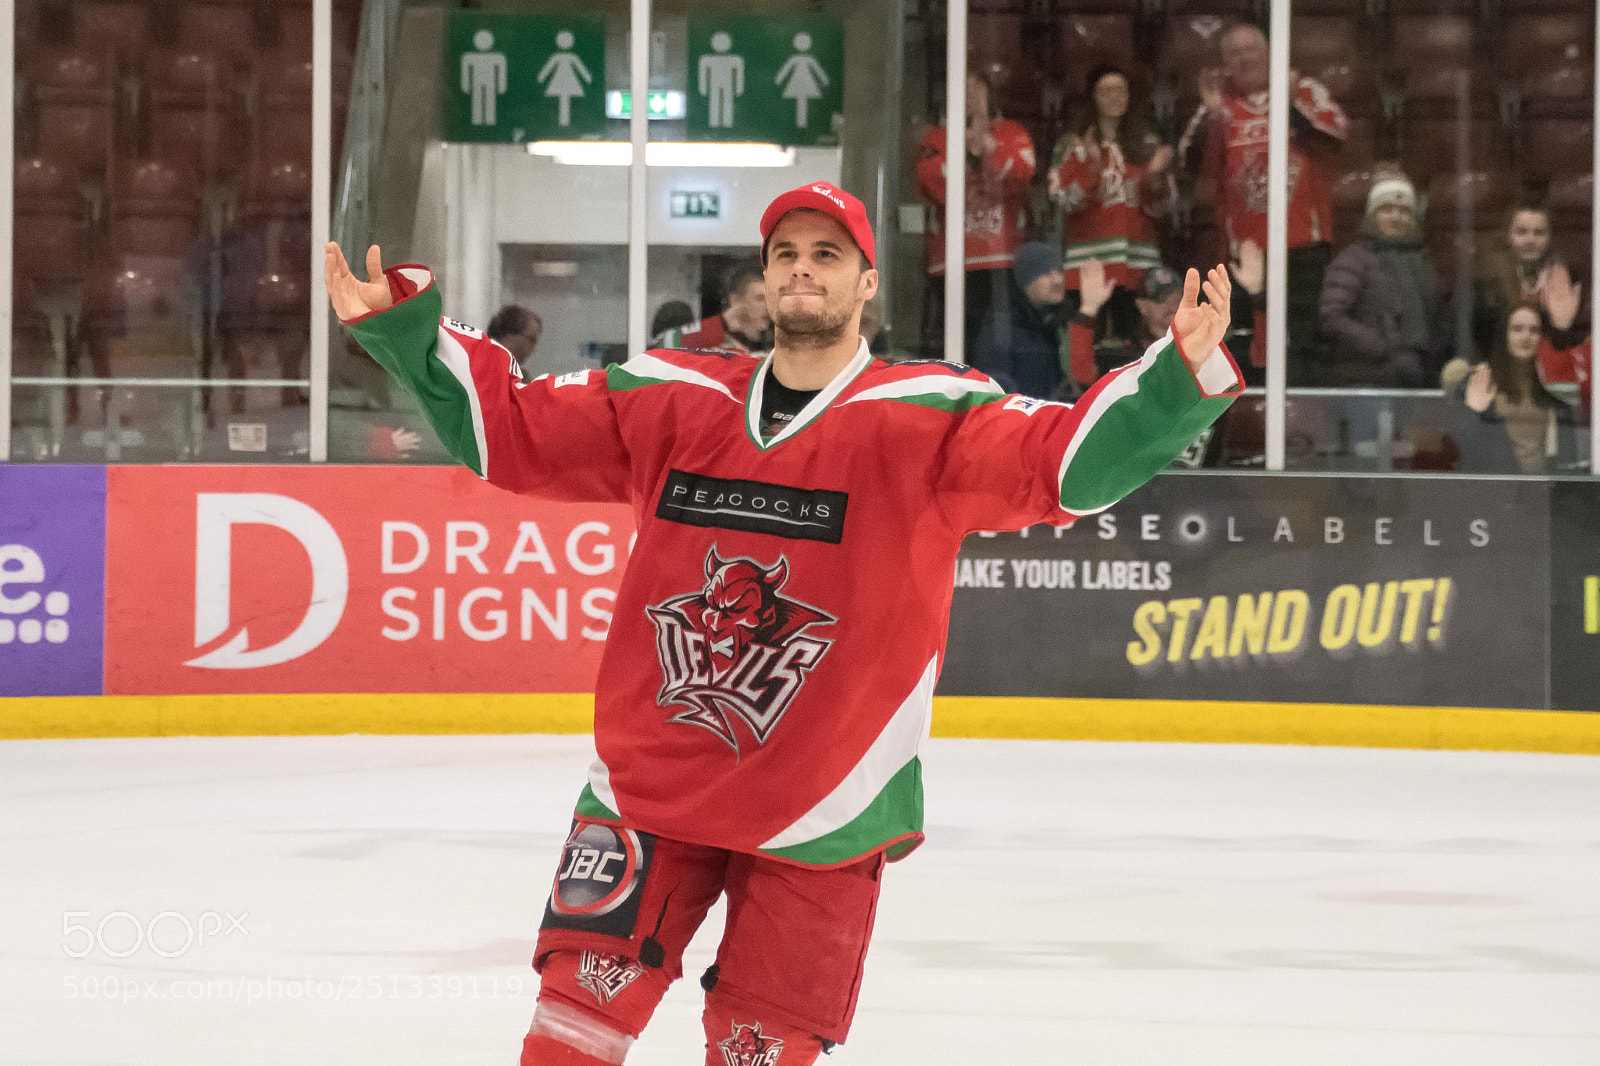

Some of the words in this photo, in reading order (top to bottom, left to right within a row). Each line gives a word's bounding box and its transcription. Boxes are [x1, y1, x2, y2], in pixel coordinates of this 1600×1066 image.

[672, 485, 831, 518] PEACOCKS
[381, 520, 638, 576] DRAG
[1011, 559, 1077, 590] YOUR
[1082, 560, 1172, 592] LABELS
[381, 586, 617, 642] SIGNS
[1126, 590, 1308, 666] STAND
[1319, 577, 1452, 652] OUT!
[652, 612, 834, 736] DEVILS
[559, 848, 626, 884] JBC
